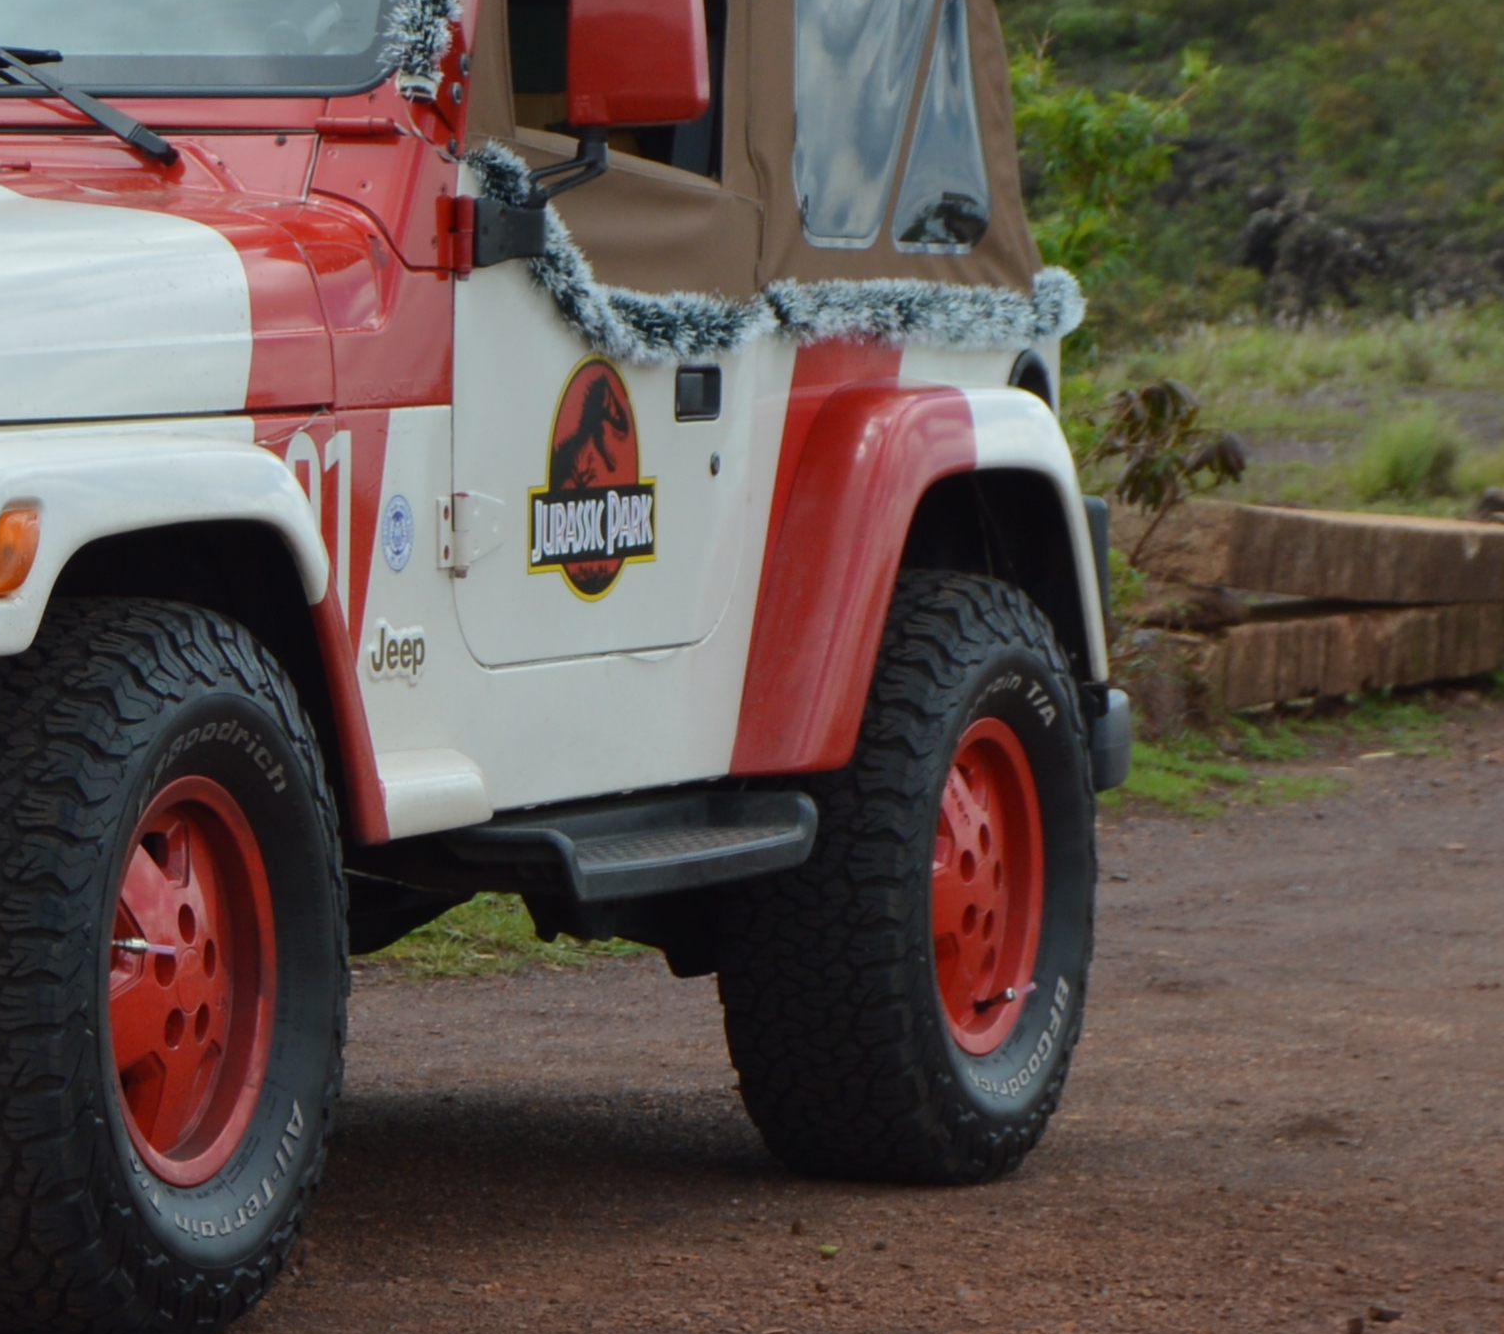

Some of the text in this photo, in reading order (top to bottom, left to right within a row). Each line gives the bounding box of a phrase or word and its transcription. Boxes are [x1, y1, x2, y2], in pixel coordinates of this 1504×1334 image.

[532, 490, 654, 563] JURASSIC PARK
[371, 626, 425, 675] Jeep
[1027, 680, 1057, 727] T/A
[174, 1099, 304, 1241] All-Terrain
